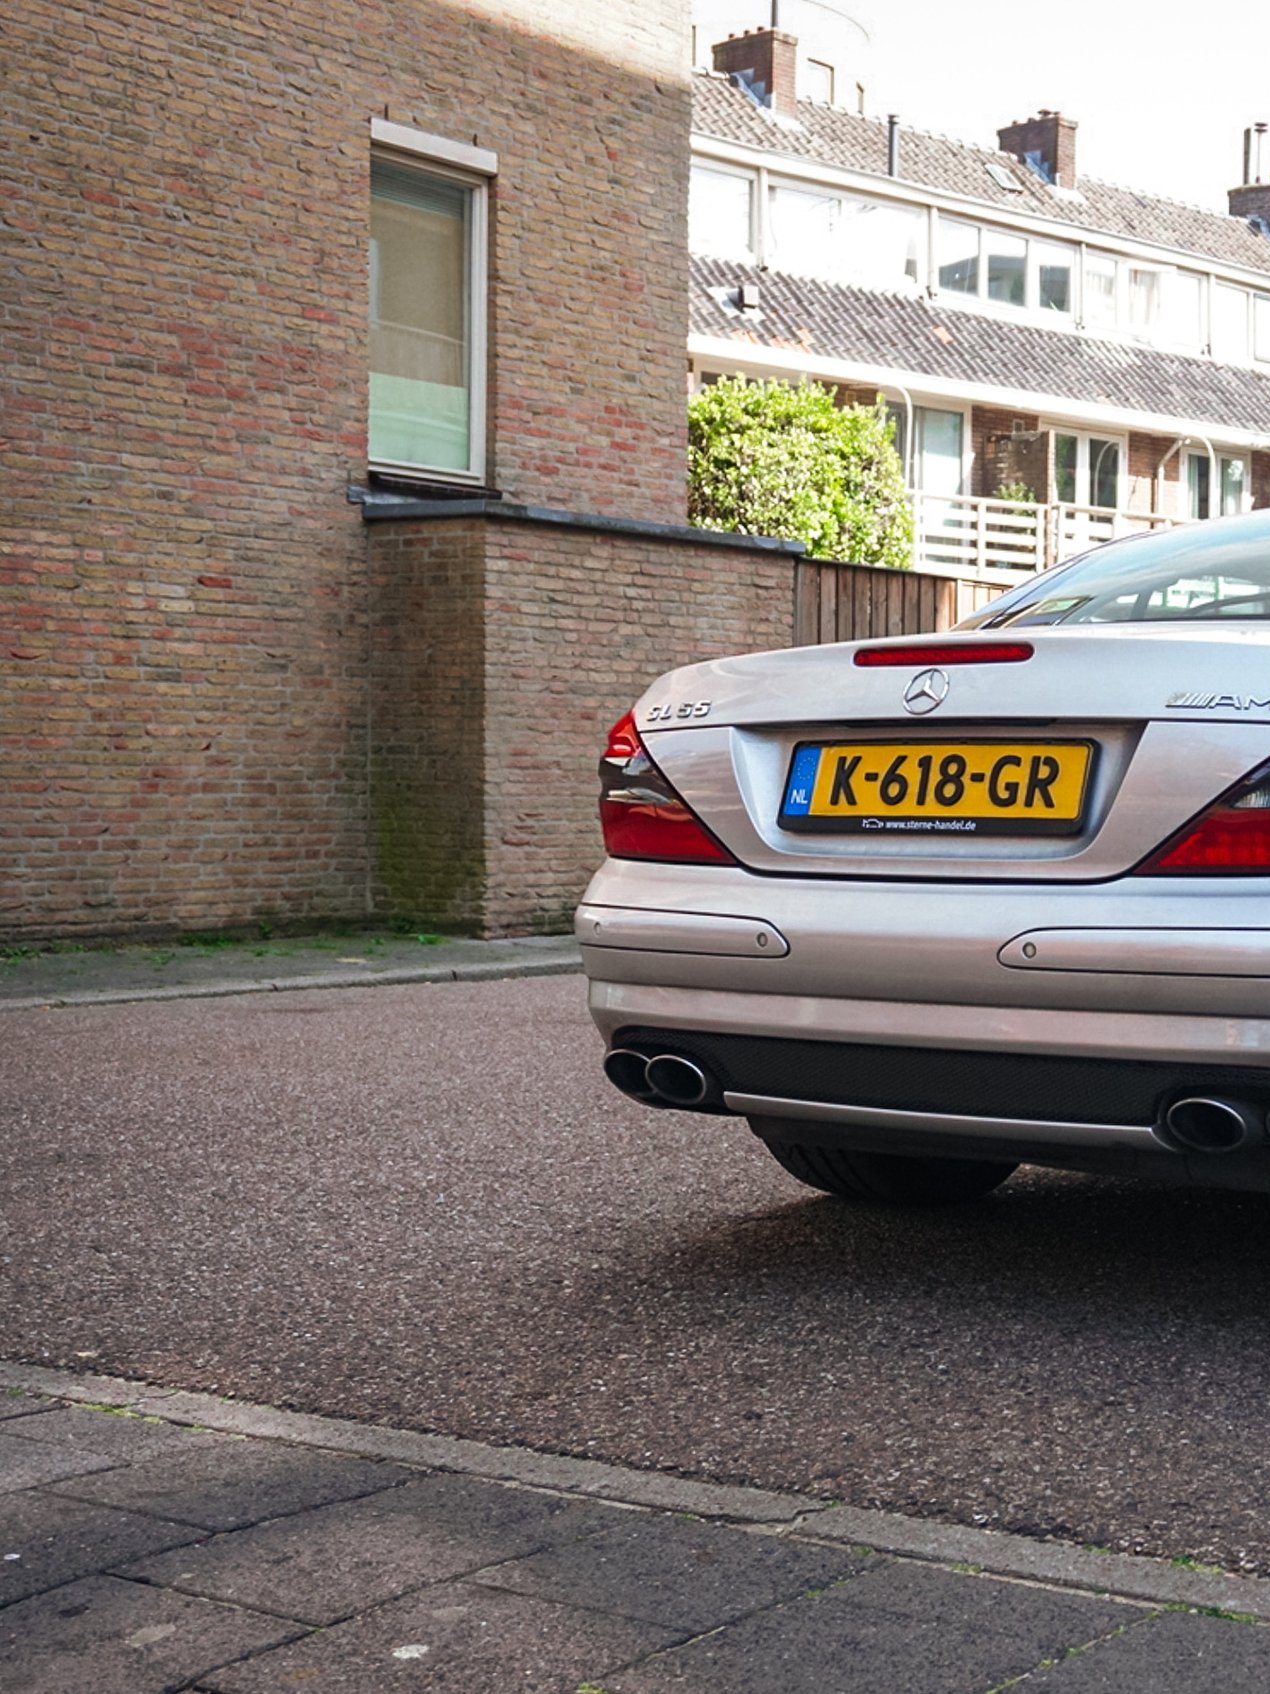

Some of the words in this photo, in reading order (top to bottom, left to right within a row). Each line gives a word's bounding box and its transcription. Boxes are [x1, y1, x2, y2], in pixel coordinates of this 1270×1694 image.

[646, 704, 671, 722] SL
[677, 700, 711, 718] 55
[830, 754, 1060, 808] K-618-GR
[790, 789, 808, 805] NL
[885, 819, 976, 832] www.sterne-handel.de
